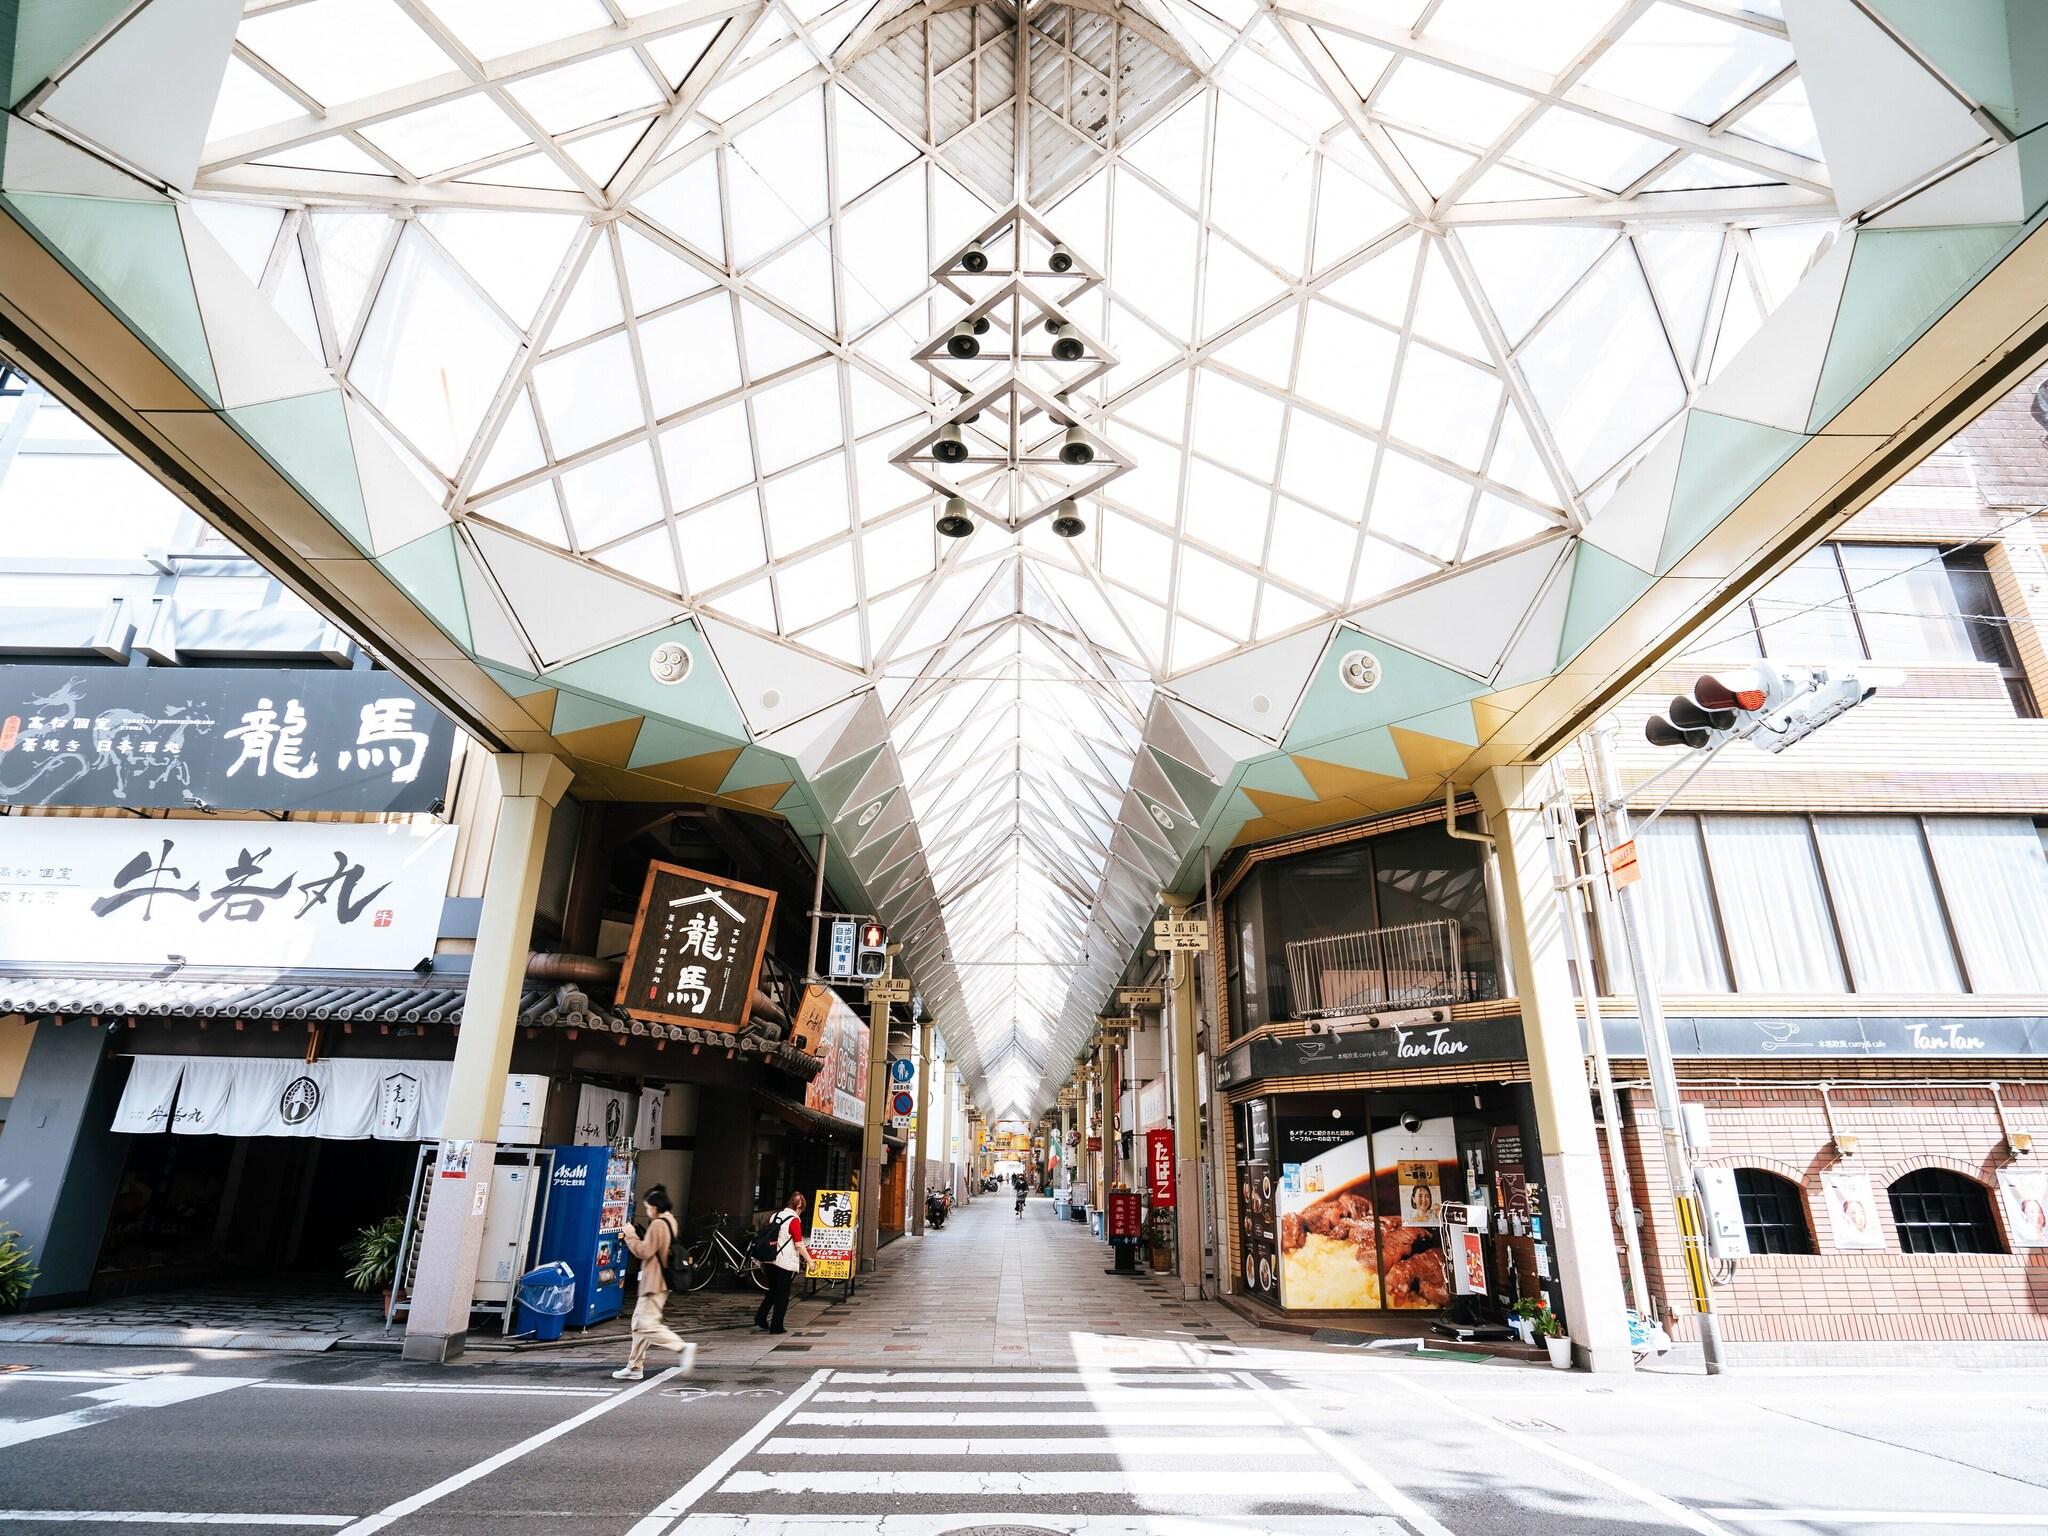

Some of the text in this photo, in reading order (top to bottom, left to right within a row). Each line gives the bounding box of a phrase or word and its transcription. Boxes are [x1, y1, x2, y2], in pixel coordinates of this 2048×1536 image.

[224, 698, 429, 783] 龍馬
[91, 840, 393, 925] 牛若丸
[834, 927, 844, 953] 自転車
[844, 927, 853, 954] 歩行者
[667, 912, 723, 1014] 龍馬
[837, 954, 847, 973] 専用
[553, 1178, 586, 1187] アサヒ飲料
[554, 1164, 588, 1178] Asahi
[1154, 1142, 1171, 1198] たばこ
[818, 1192, 852, 1228] 半額
